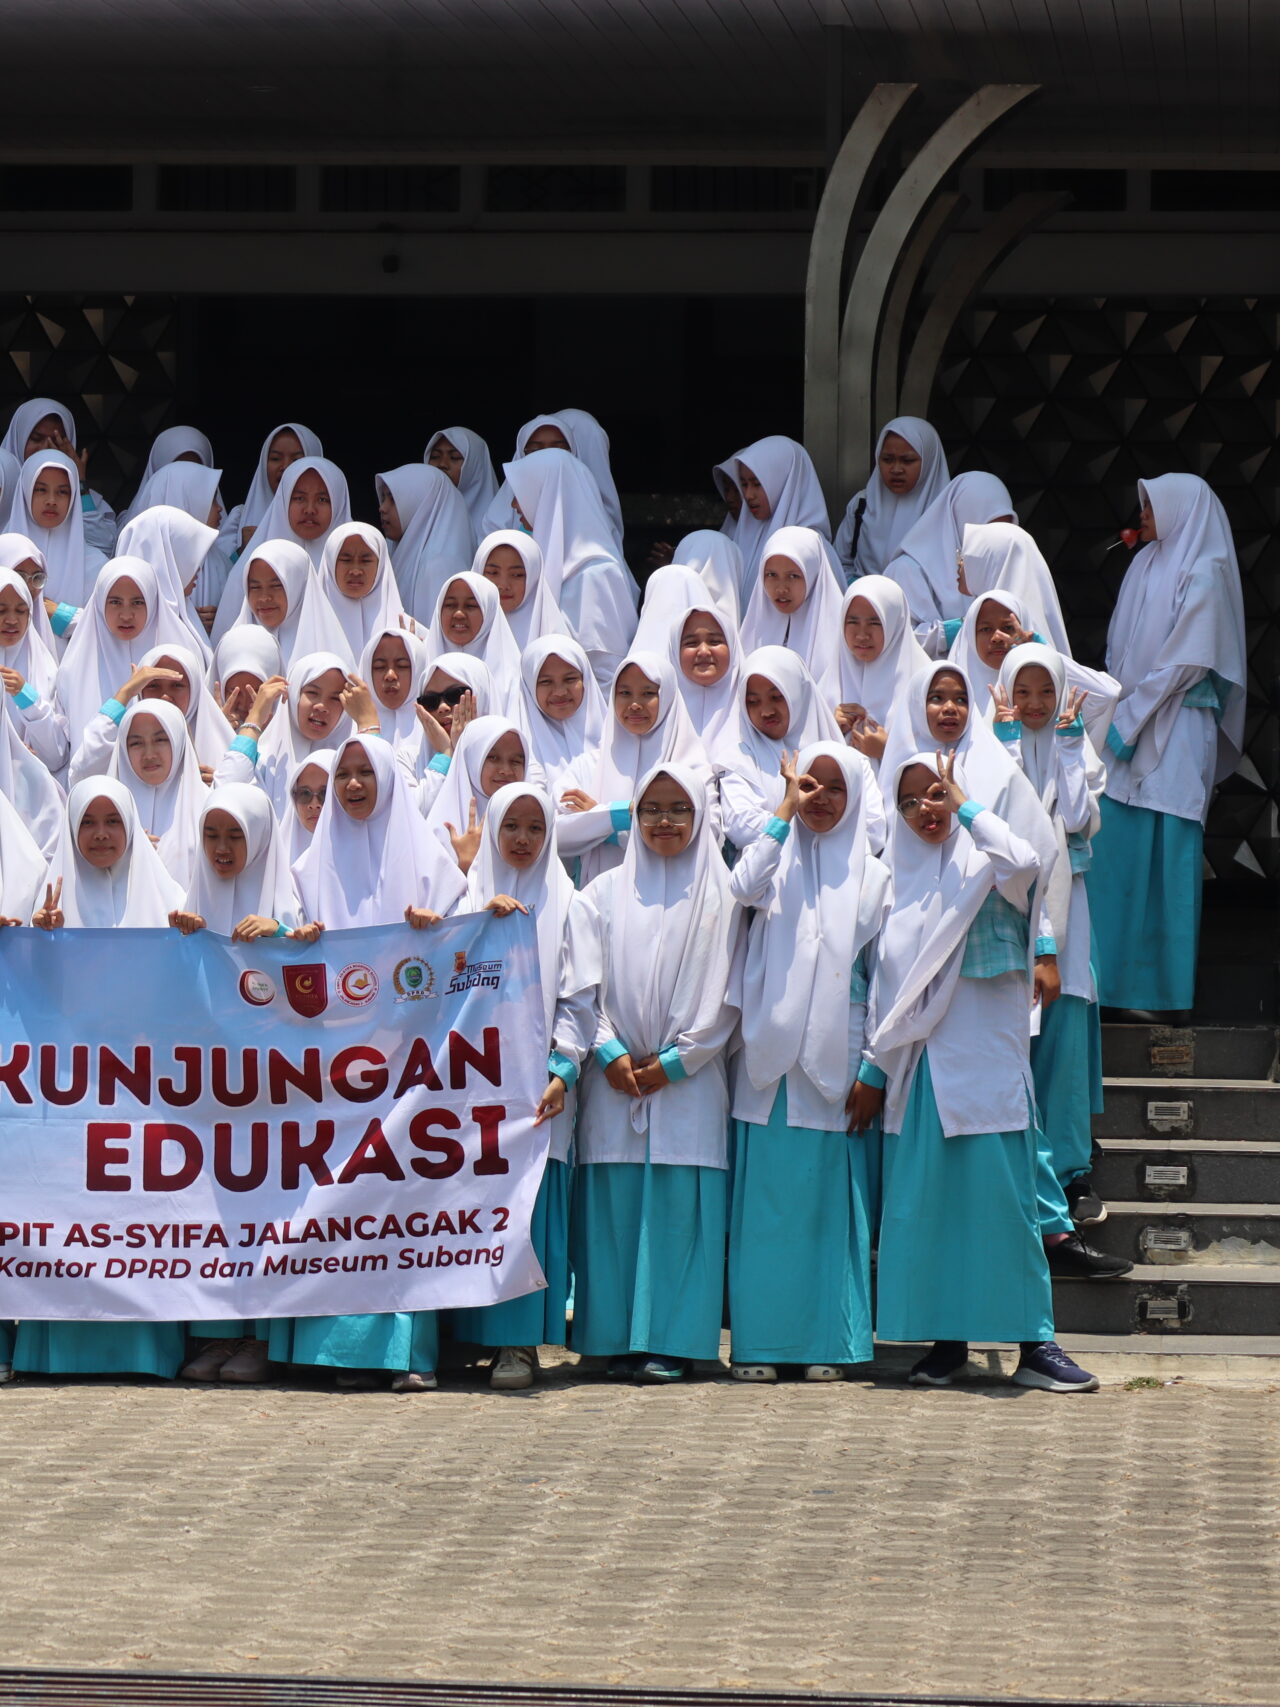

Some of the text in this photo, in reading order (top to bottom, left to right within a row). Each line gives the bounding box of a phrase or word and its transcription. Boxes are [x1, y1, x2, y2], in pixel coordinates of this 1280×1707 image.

[85, 1104, 510, 1193] EDUKASI
[63, 1223, 230, 1249] AS-SYIFA
[238, 1208, 483, 1249] JALANCAGAK
[491, 1207, 510, 1233] 2
[104, 1258, 192, 1279] DPRD
[199, 1257, 254, 1279] dan
[263, 1254, 389, 1278] Museum
[397, 1245, 505, 1269] Subang
